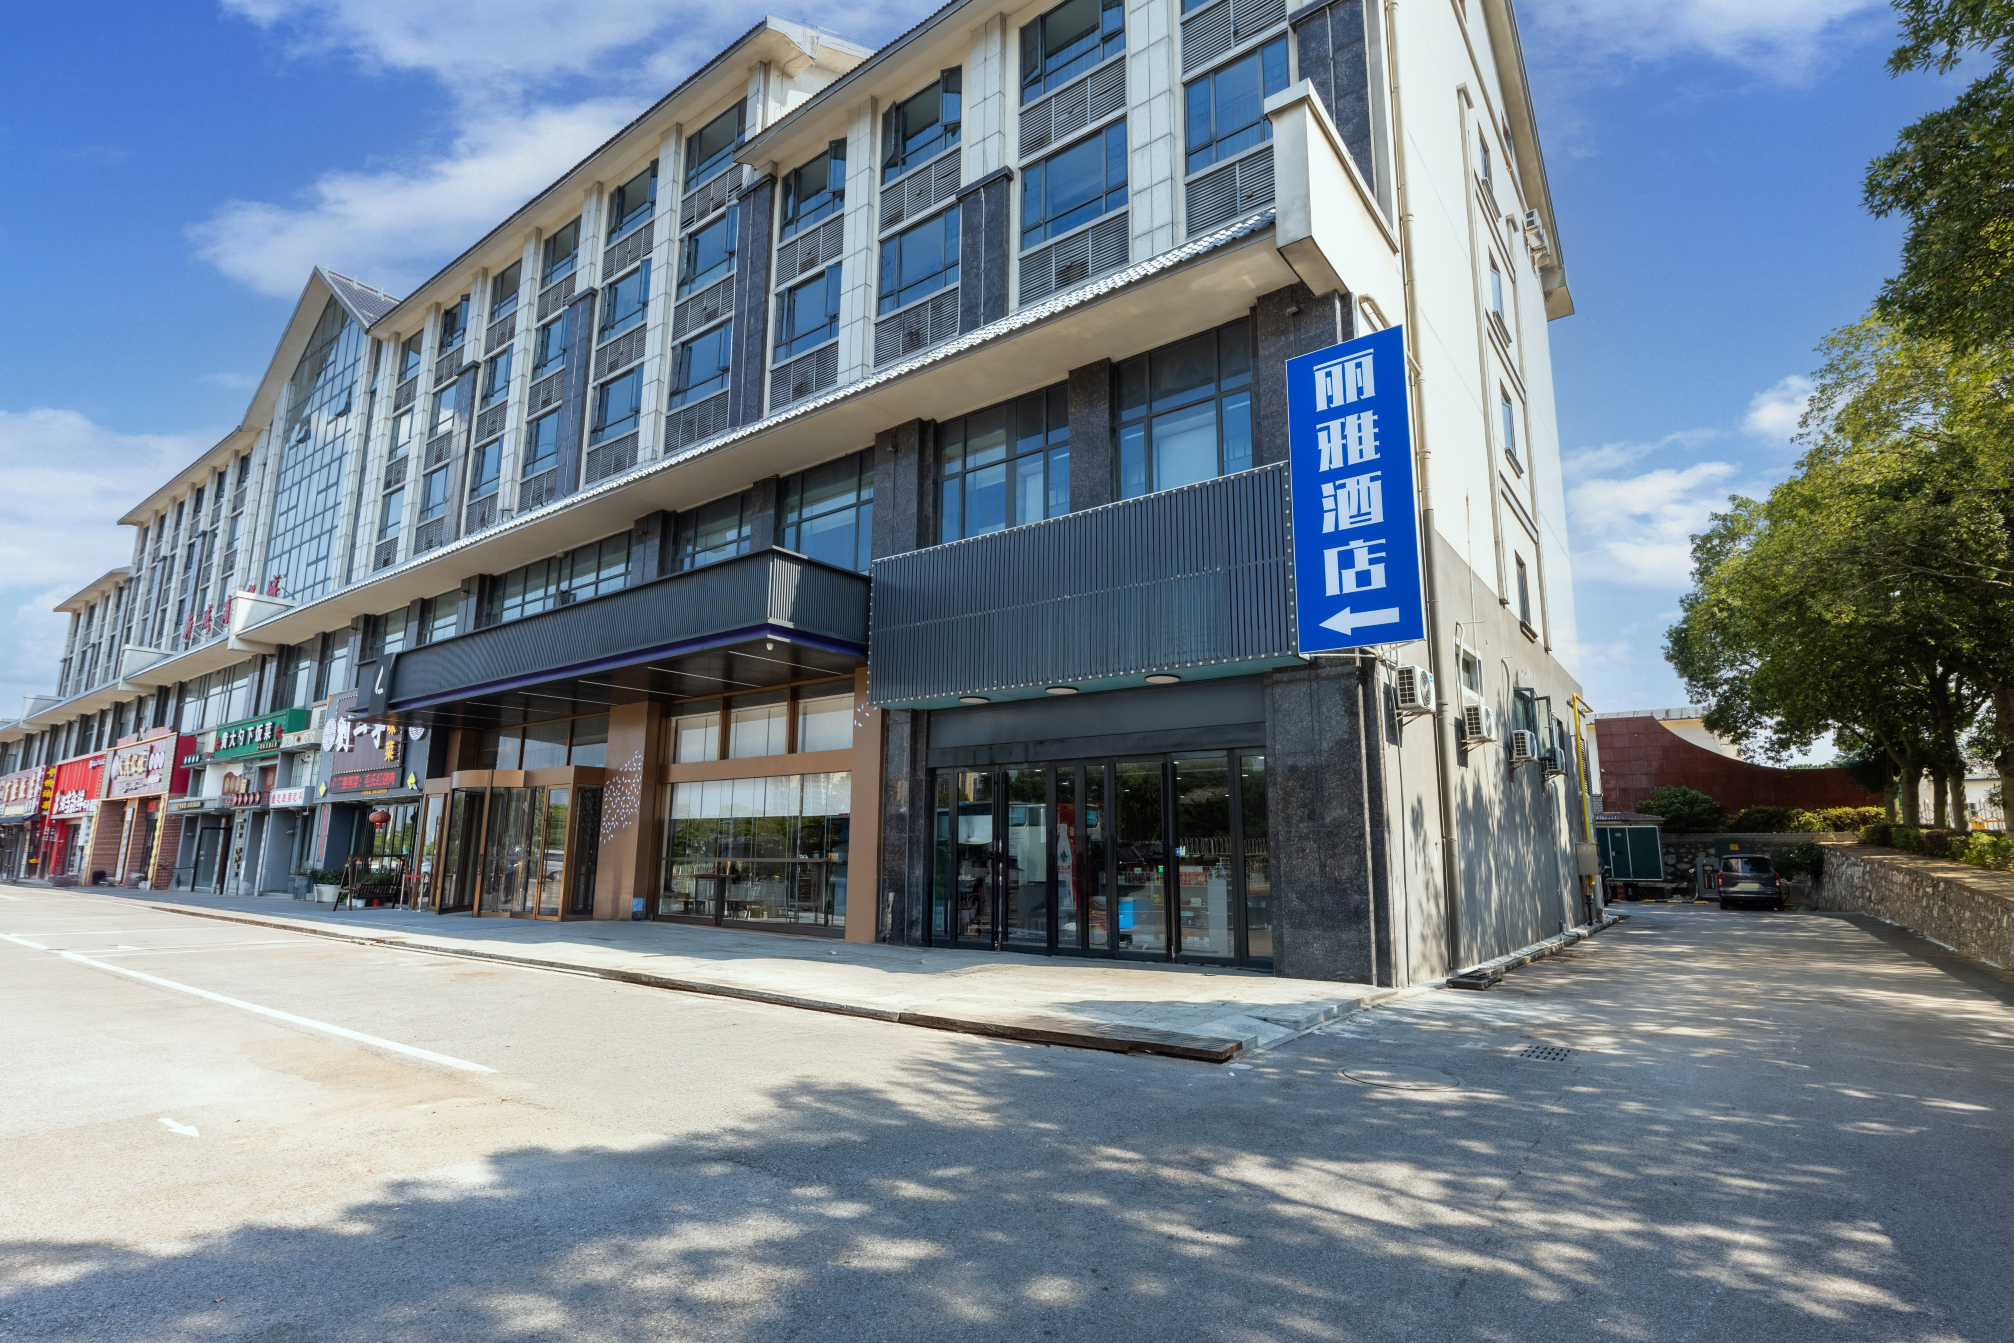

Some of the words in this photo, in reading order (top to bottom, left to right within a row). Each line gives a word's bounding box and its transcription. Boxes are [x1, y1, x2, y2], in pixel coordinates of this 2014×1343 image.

[1313, 348, 1387, 597] 丽雅酒店
[221, 721, 274, 750] 黄大勺下饭菜
